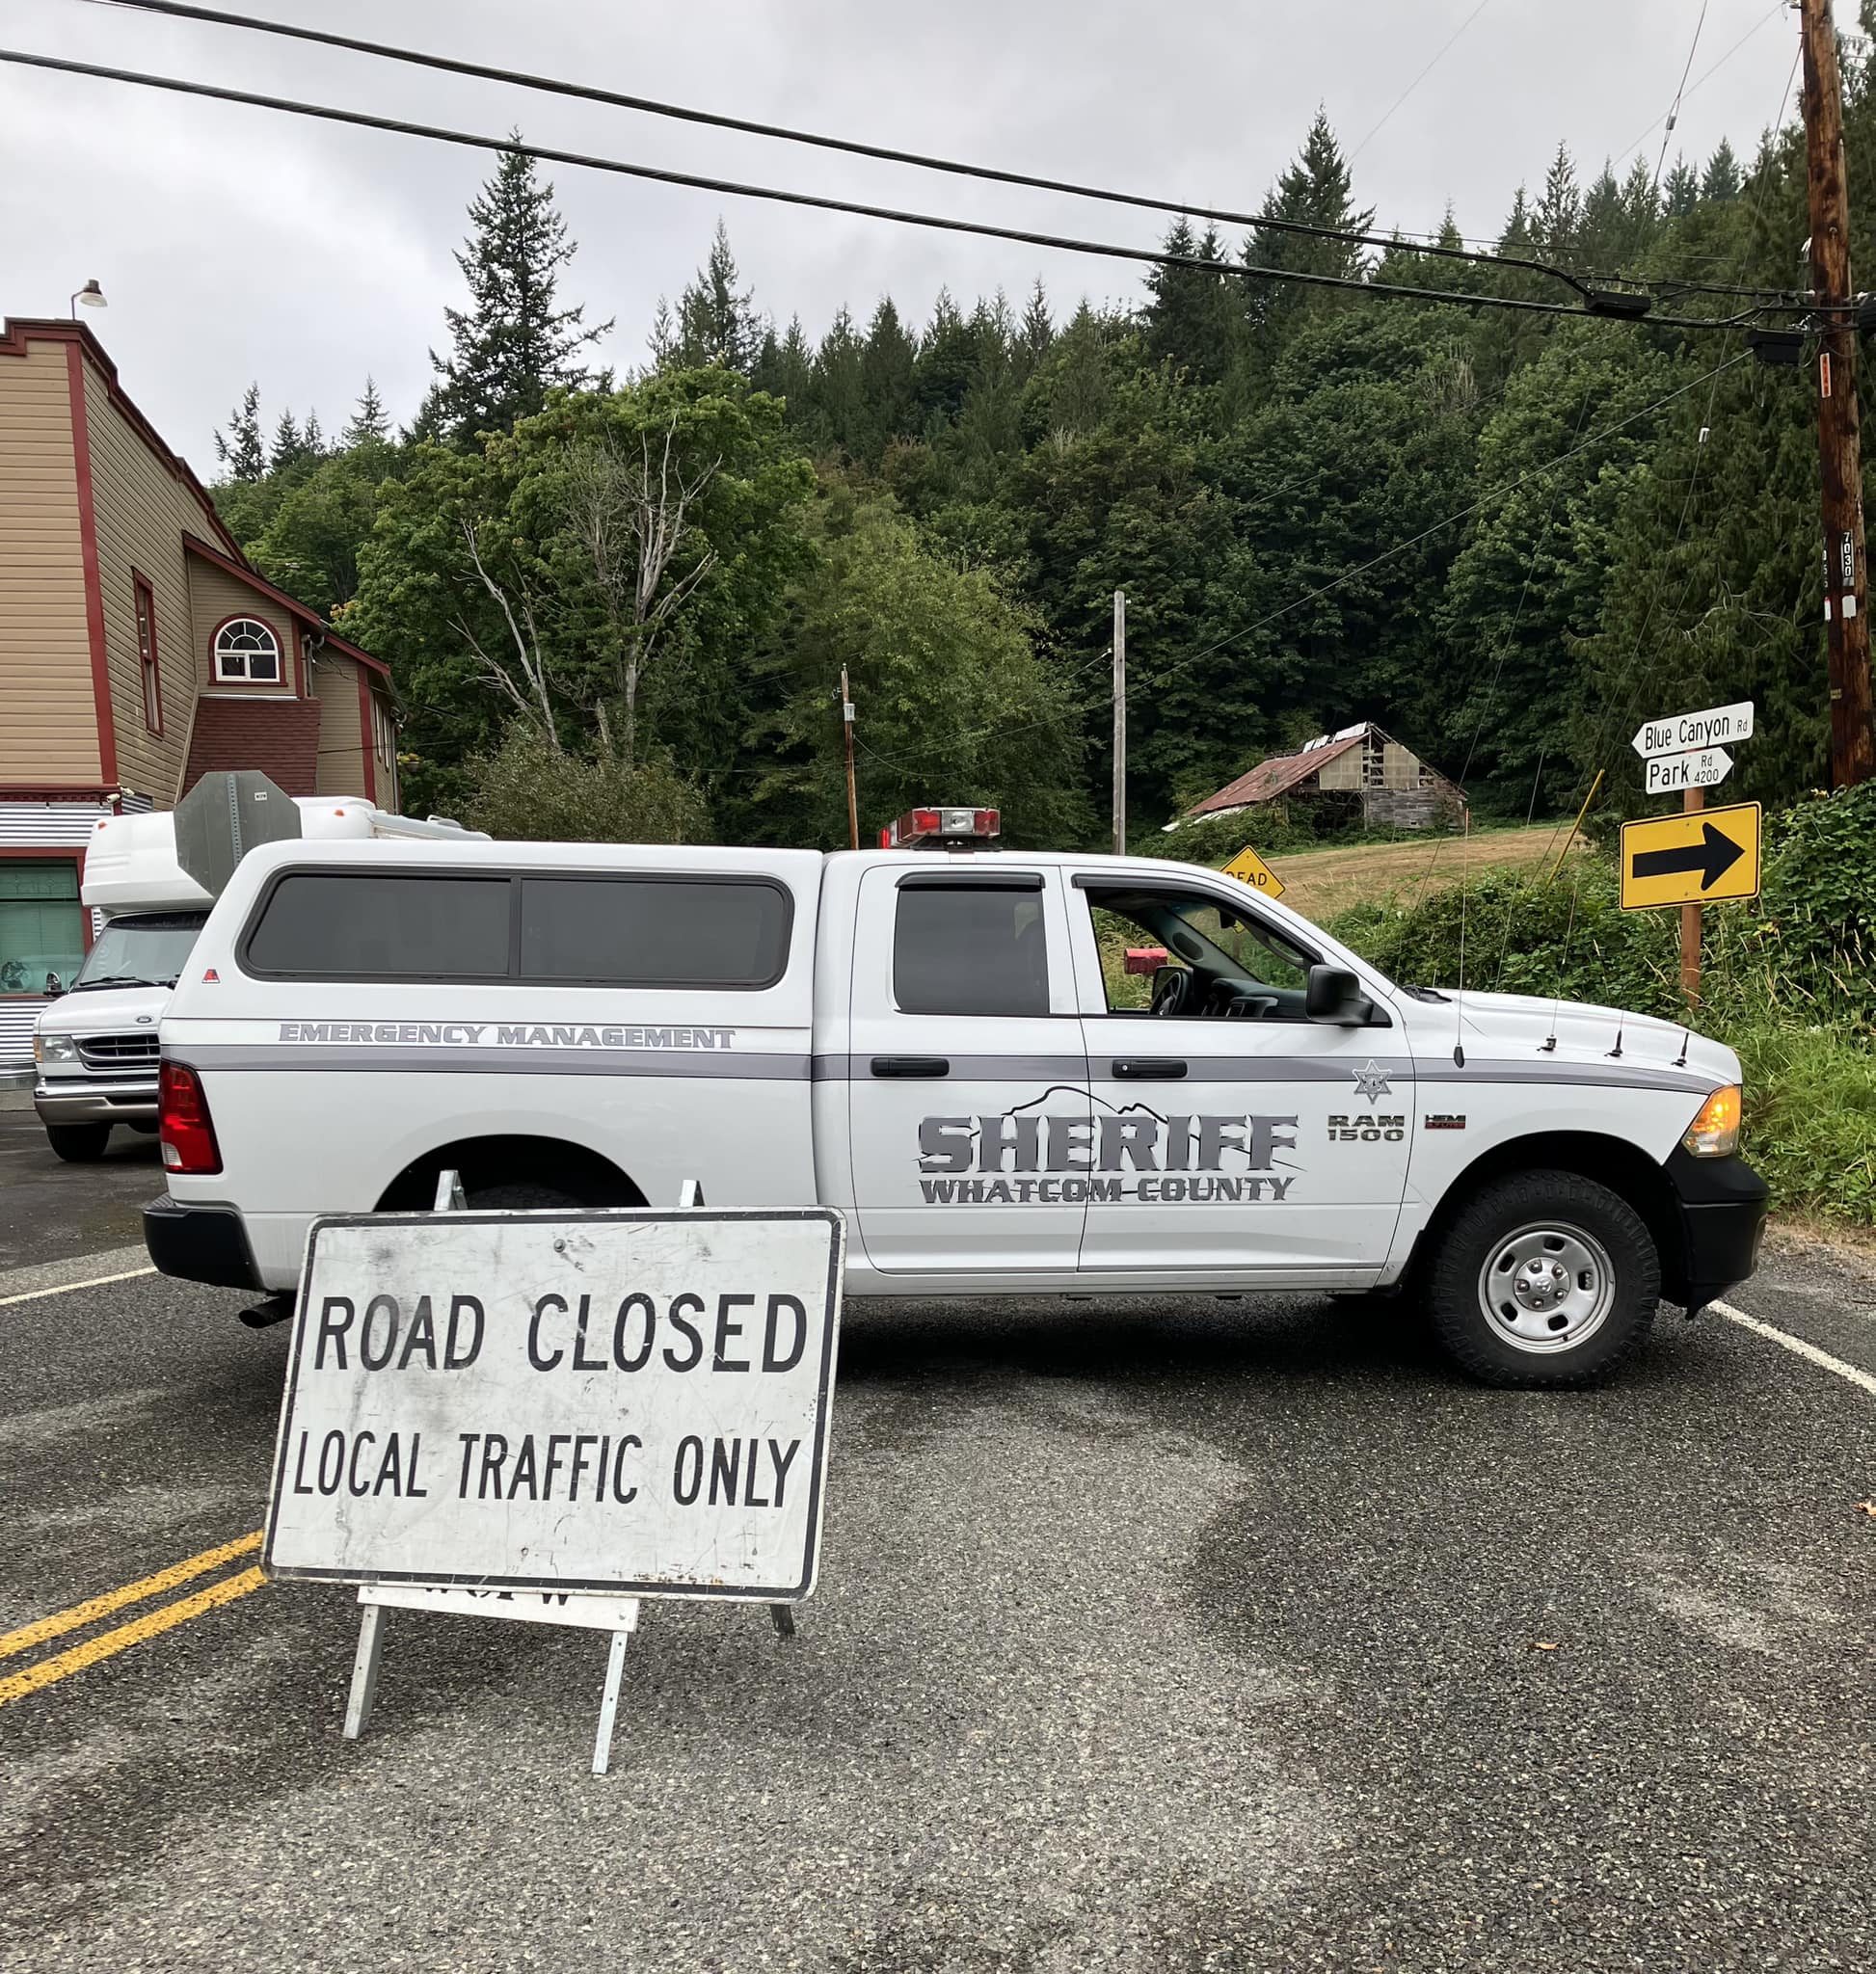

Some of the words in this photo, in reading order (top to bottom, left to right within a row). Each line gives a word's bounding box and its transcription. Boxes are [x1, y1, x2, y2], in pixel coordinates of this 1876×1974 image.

[1645, 726, 1673, 751] Blue
[1678, 716, 1729, 748] Canyon
[1736, 719, 1748, 734] Rd
[1649, 760, 1690, 787] Park
[1701, 755, 1713, 768] Rd
[1694, 768, 1719, 783] 4200
[279, 1023, 487, 1045] EMERGENCY
[496, 1026, 736, 1049] MANAGEMENT
[1327, 1115, 1405, 1127] RAM
[1327, 1129, 1405, 1141] 1500
[918, 1115, 1299, 1173] SHERIFF
[918, 1178, 1125, 1204] WHATCOM
[1136, 1177, 1296, 1202] COUNTY
[314, 1293, 486, 1372] ROAD
[527, 1292, 808, 1374] CLOSED
[293, 1429, 429, 1498] LOCAL
[458, 1432, 643, 1505] TRAFFIC
[674, 1434, 801, 1507] ONLY
